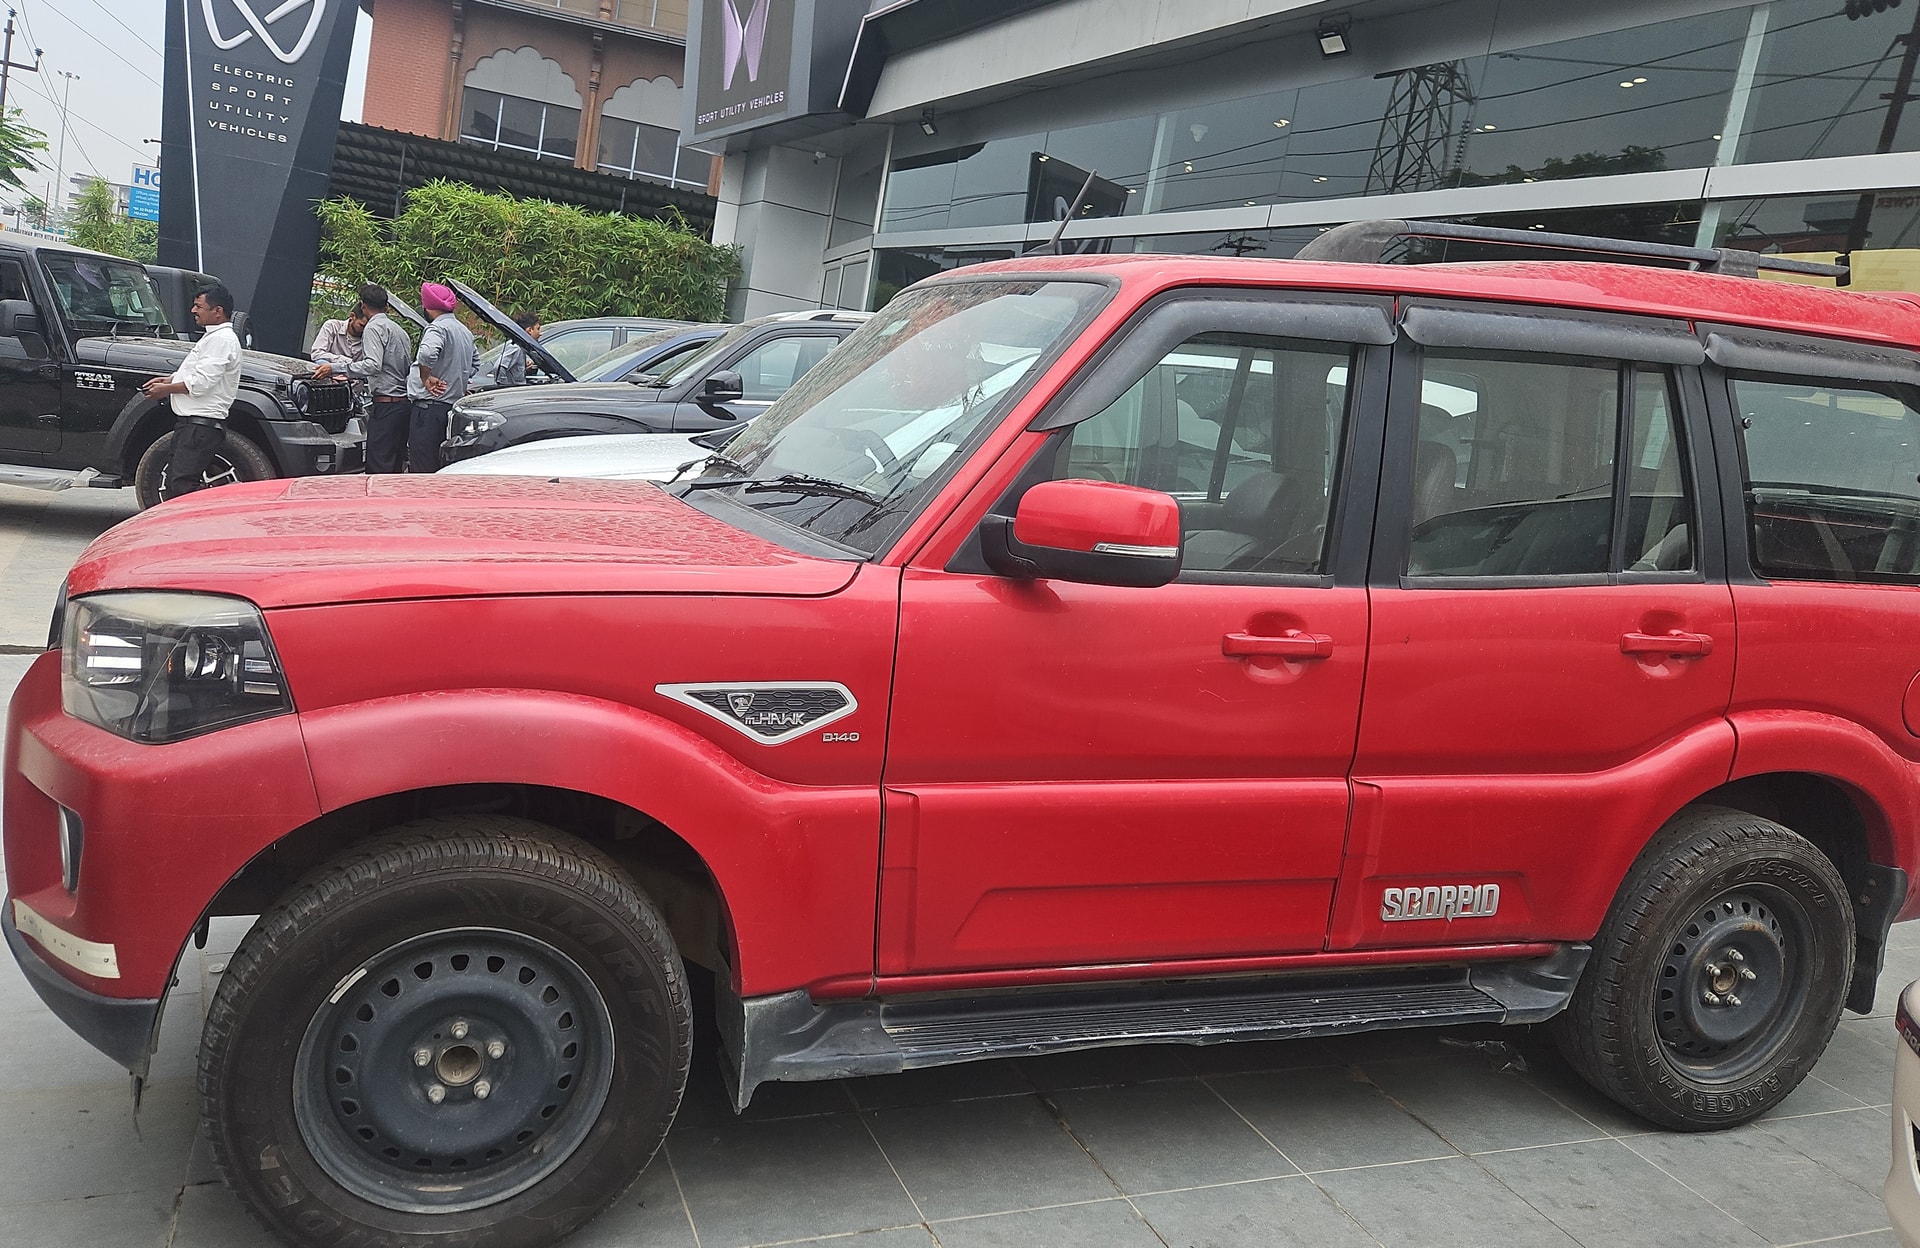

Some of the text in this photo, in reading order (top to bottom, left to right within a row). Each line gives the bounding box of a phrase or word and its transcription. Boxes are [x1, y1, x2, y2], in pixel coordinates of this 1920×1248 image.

[213, 63, 294, 88] ELECTRIC
[211, 82, 292, 106] SPORT
[209, 101, 290, 124] UTILITY
[697, 91, 784, 125] SPORT UTILITY VEHICLES
[207, 119, 289, 143] VEHICLES
[744, 712, 806, 726] mHAWK
[822, 732, 860, 743] D140
[1381, 883, 1500, 923] SCORPIO
[1691, 1072, 1784, 1114] RANGER
